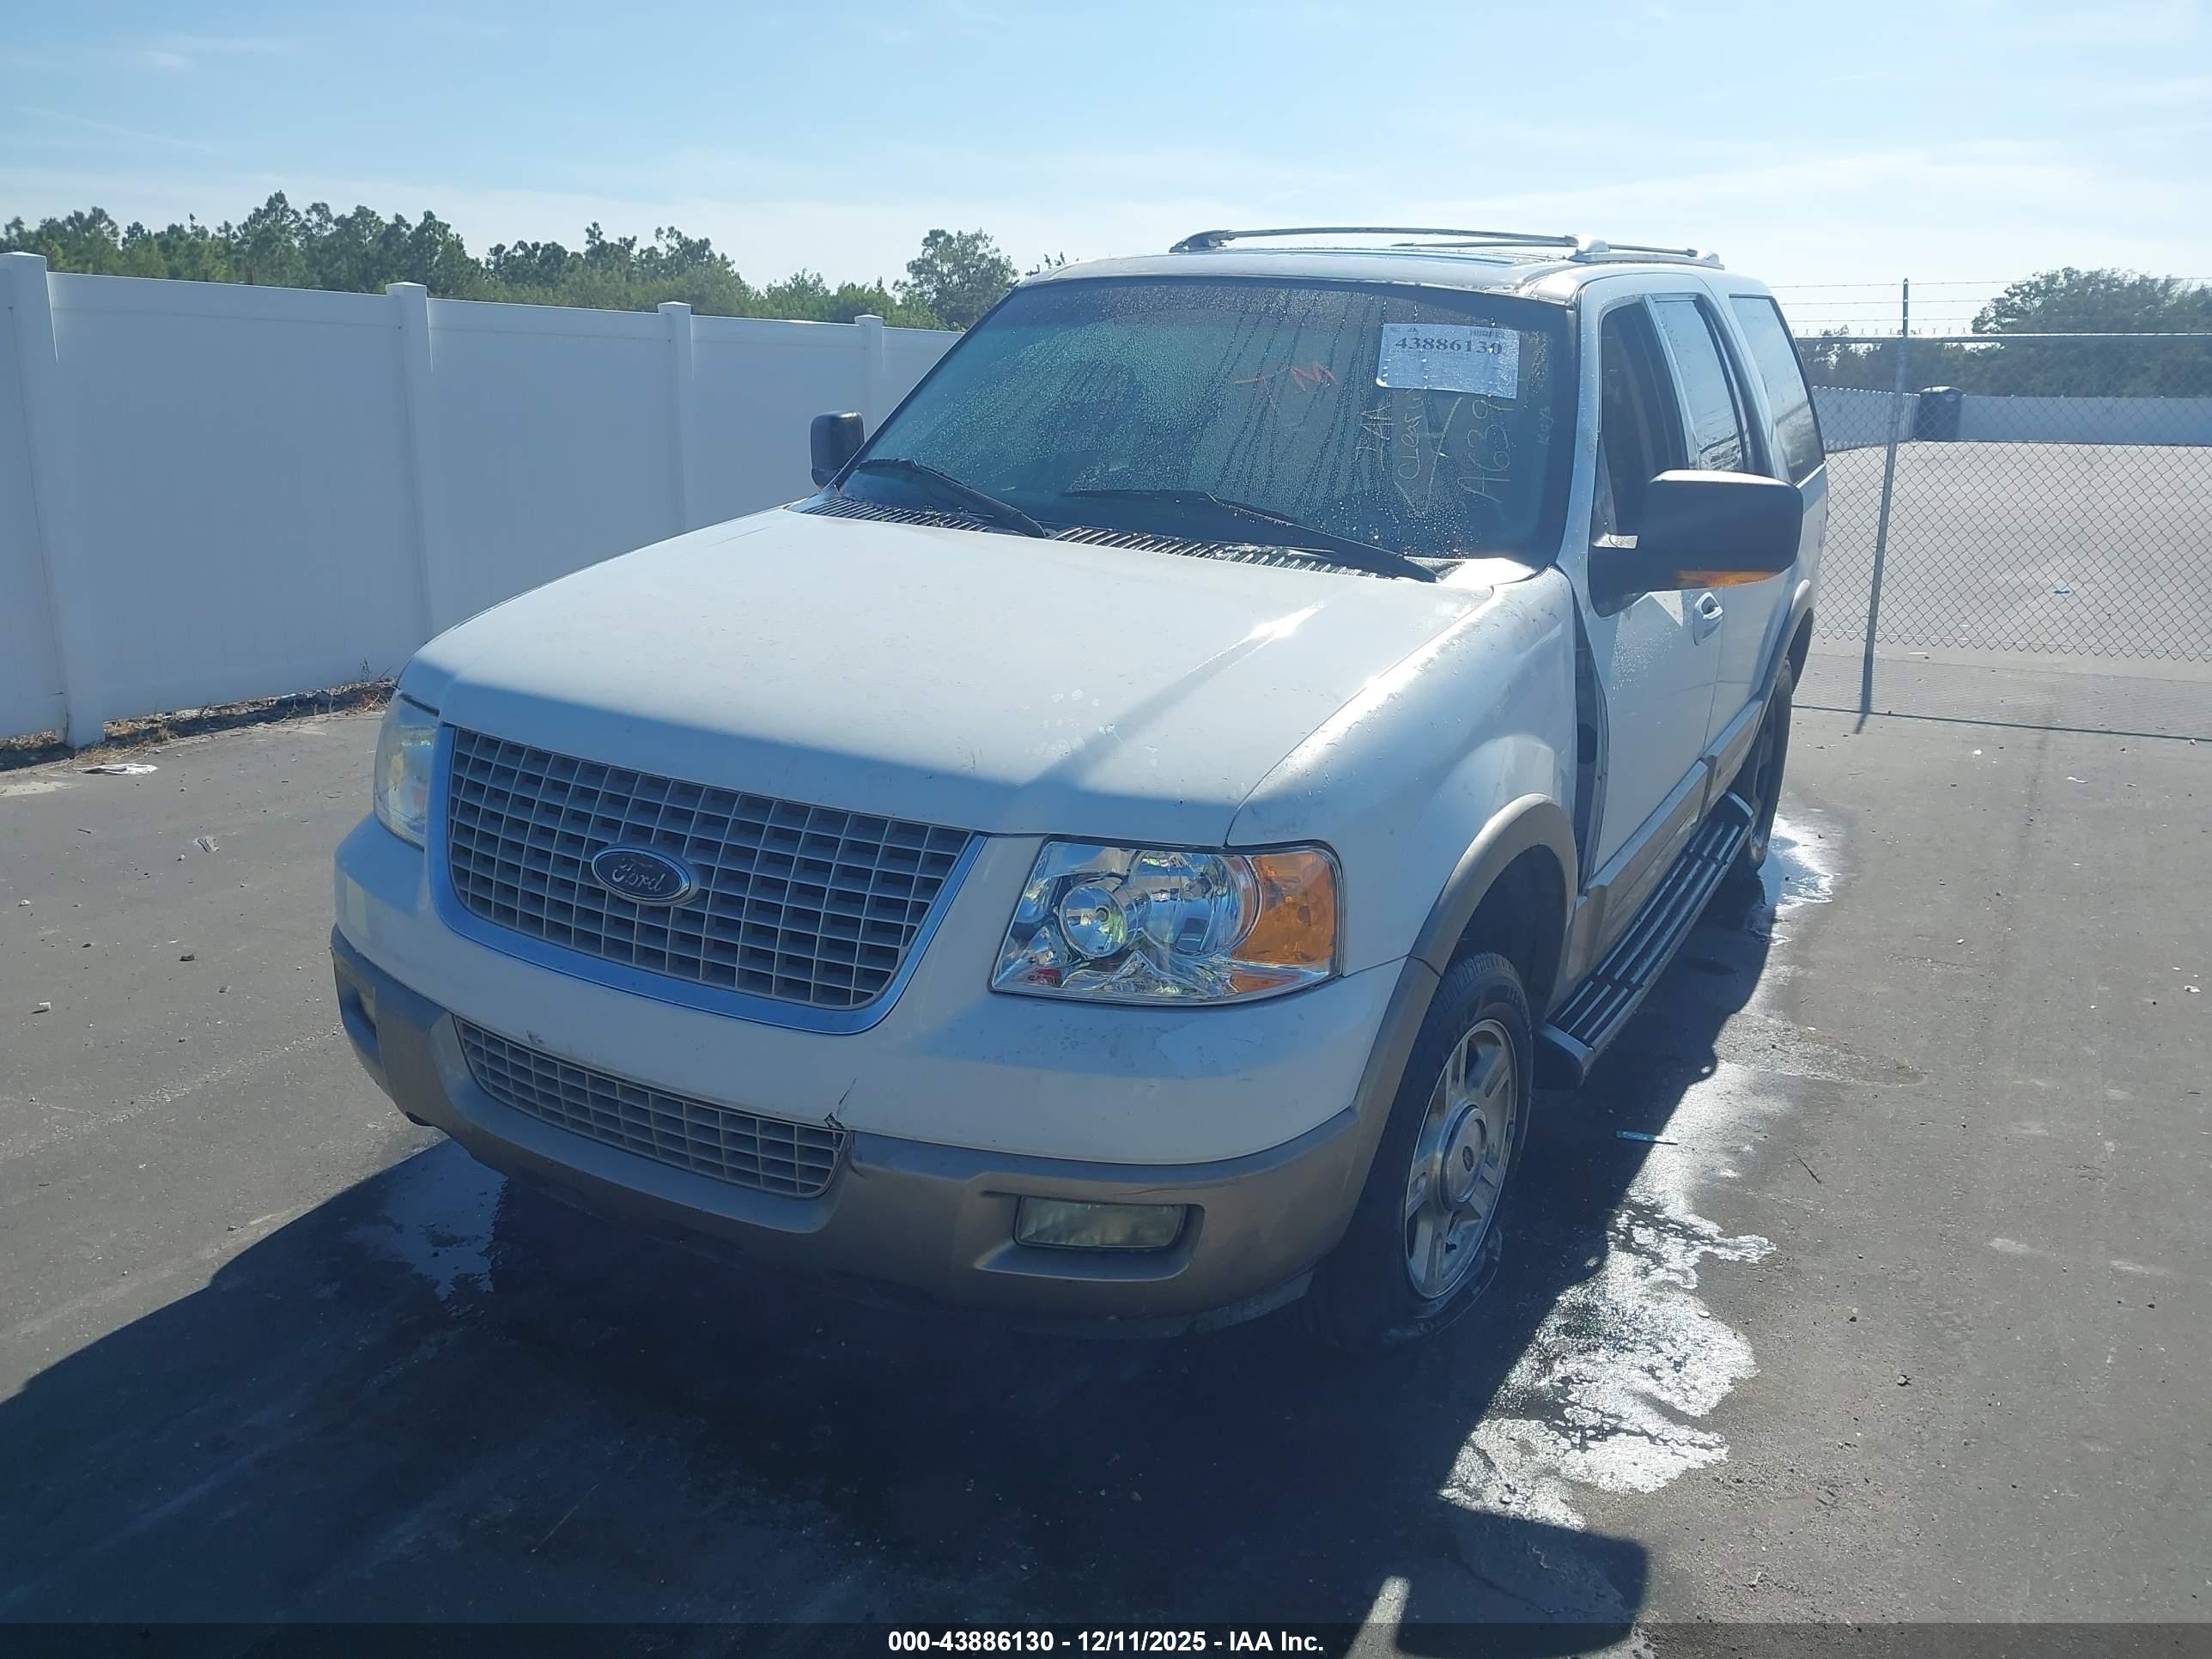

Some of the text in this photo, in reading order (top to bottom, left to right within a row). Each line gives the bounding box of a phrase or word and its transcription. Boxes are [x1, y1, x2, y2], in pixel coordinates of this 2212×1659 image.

[1395, 337, 1503, 356] 43886130
[1456, 398, 1514, 503] A639
[611, 857, 666, 892] Ford
